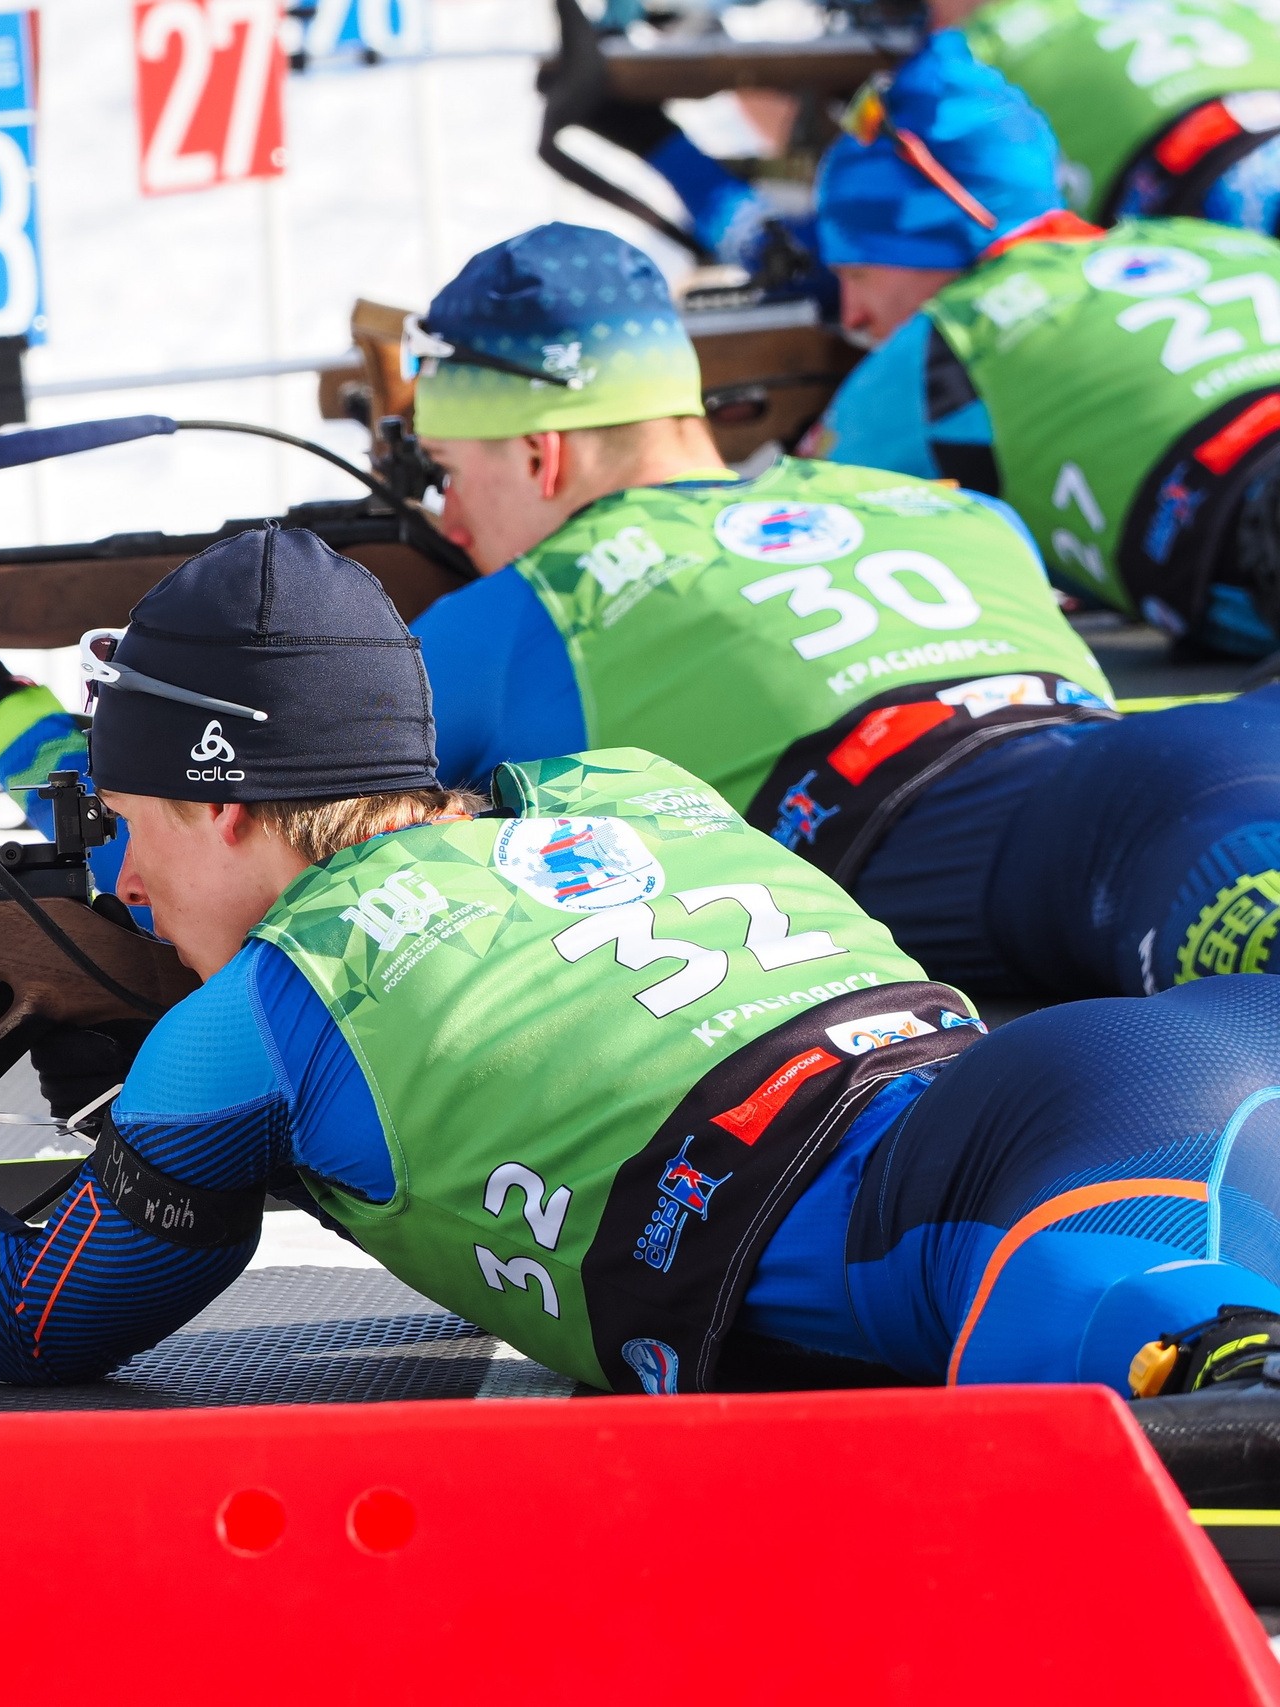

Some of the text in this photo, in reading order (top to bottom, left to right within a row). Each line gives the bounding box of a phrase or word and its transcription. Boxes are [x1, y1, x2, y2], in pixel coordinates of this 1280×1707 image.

[140, 0, 274, 188] 27
[1115, 272, 1280, 374] 27
[739, 549, 982, 661] 30
[827, 639, 1019, 696] КРАСНОЯРСК
[186, 765, 245, 782] odlo
[404, 872, 426, 888] ЛЕТ
[380, 899, 487, 981] МИНИСТЕРСТВО СПОРТА
[383, 904, 498, 994] РОССИЙСКОЙ ФЕДЕРАЦИИ
[552, 883, 850, 1020] 32
[758, 1053, 824, 1099] СНОЯРСКИЙ
[473, 1161, 573, 1321] 32
[644, 1199, 680, 1269] СБР
